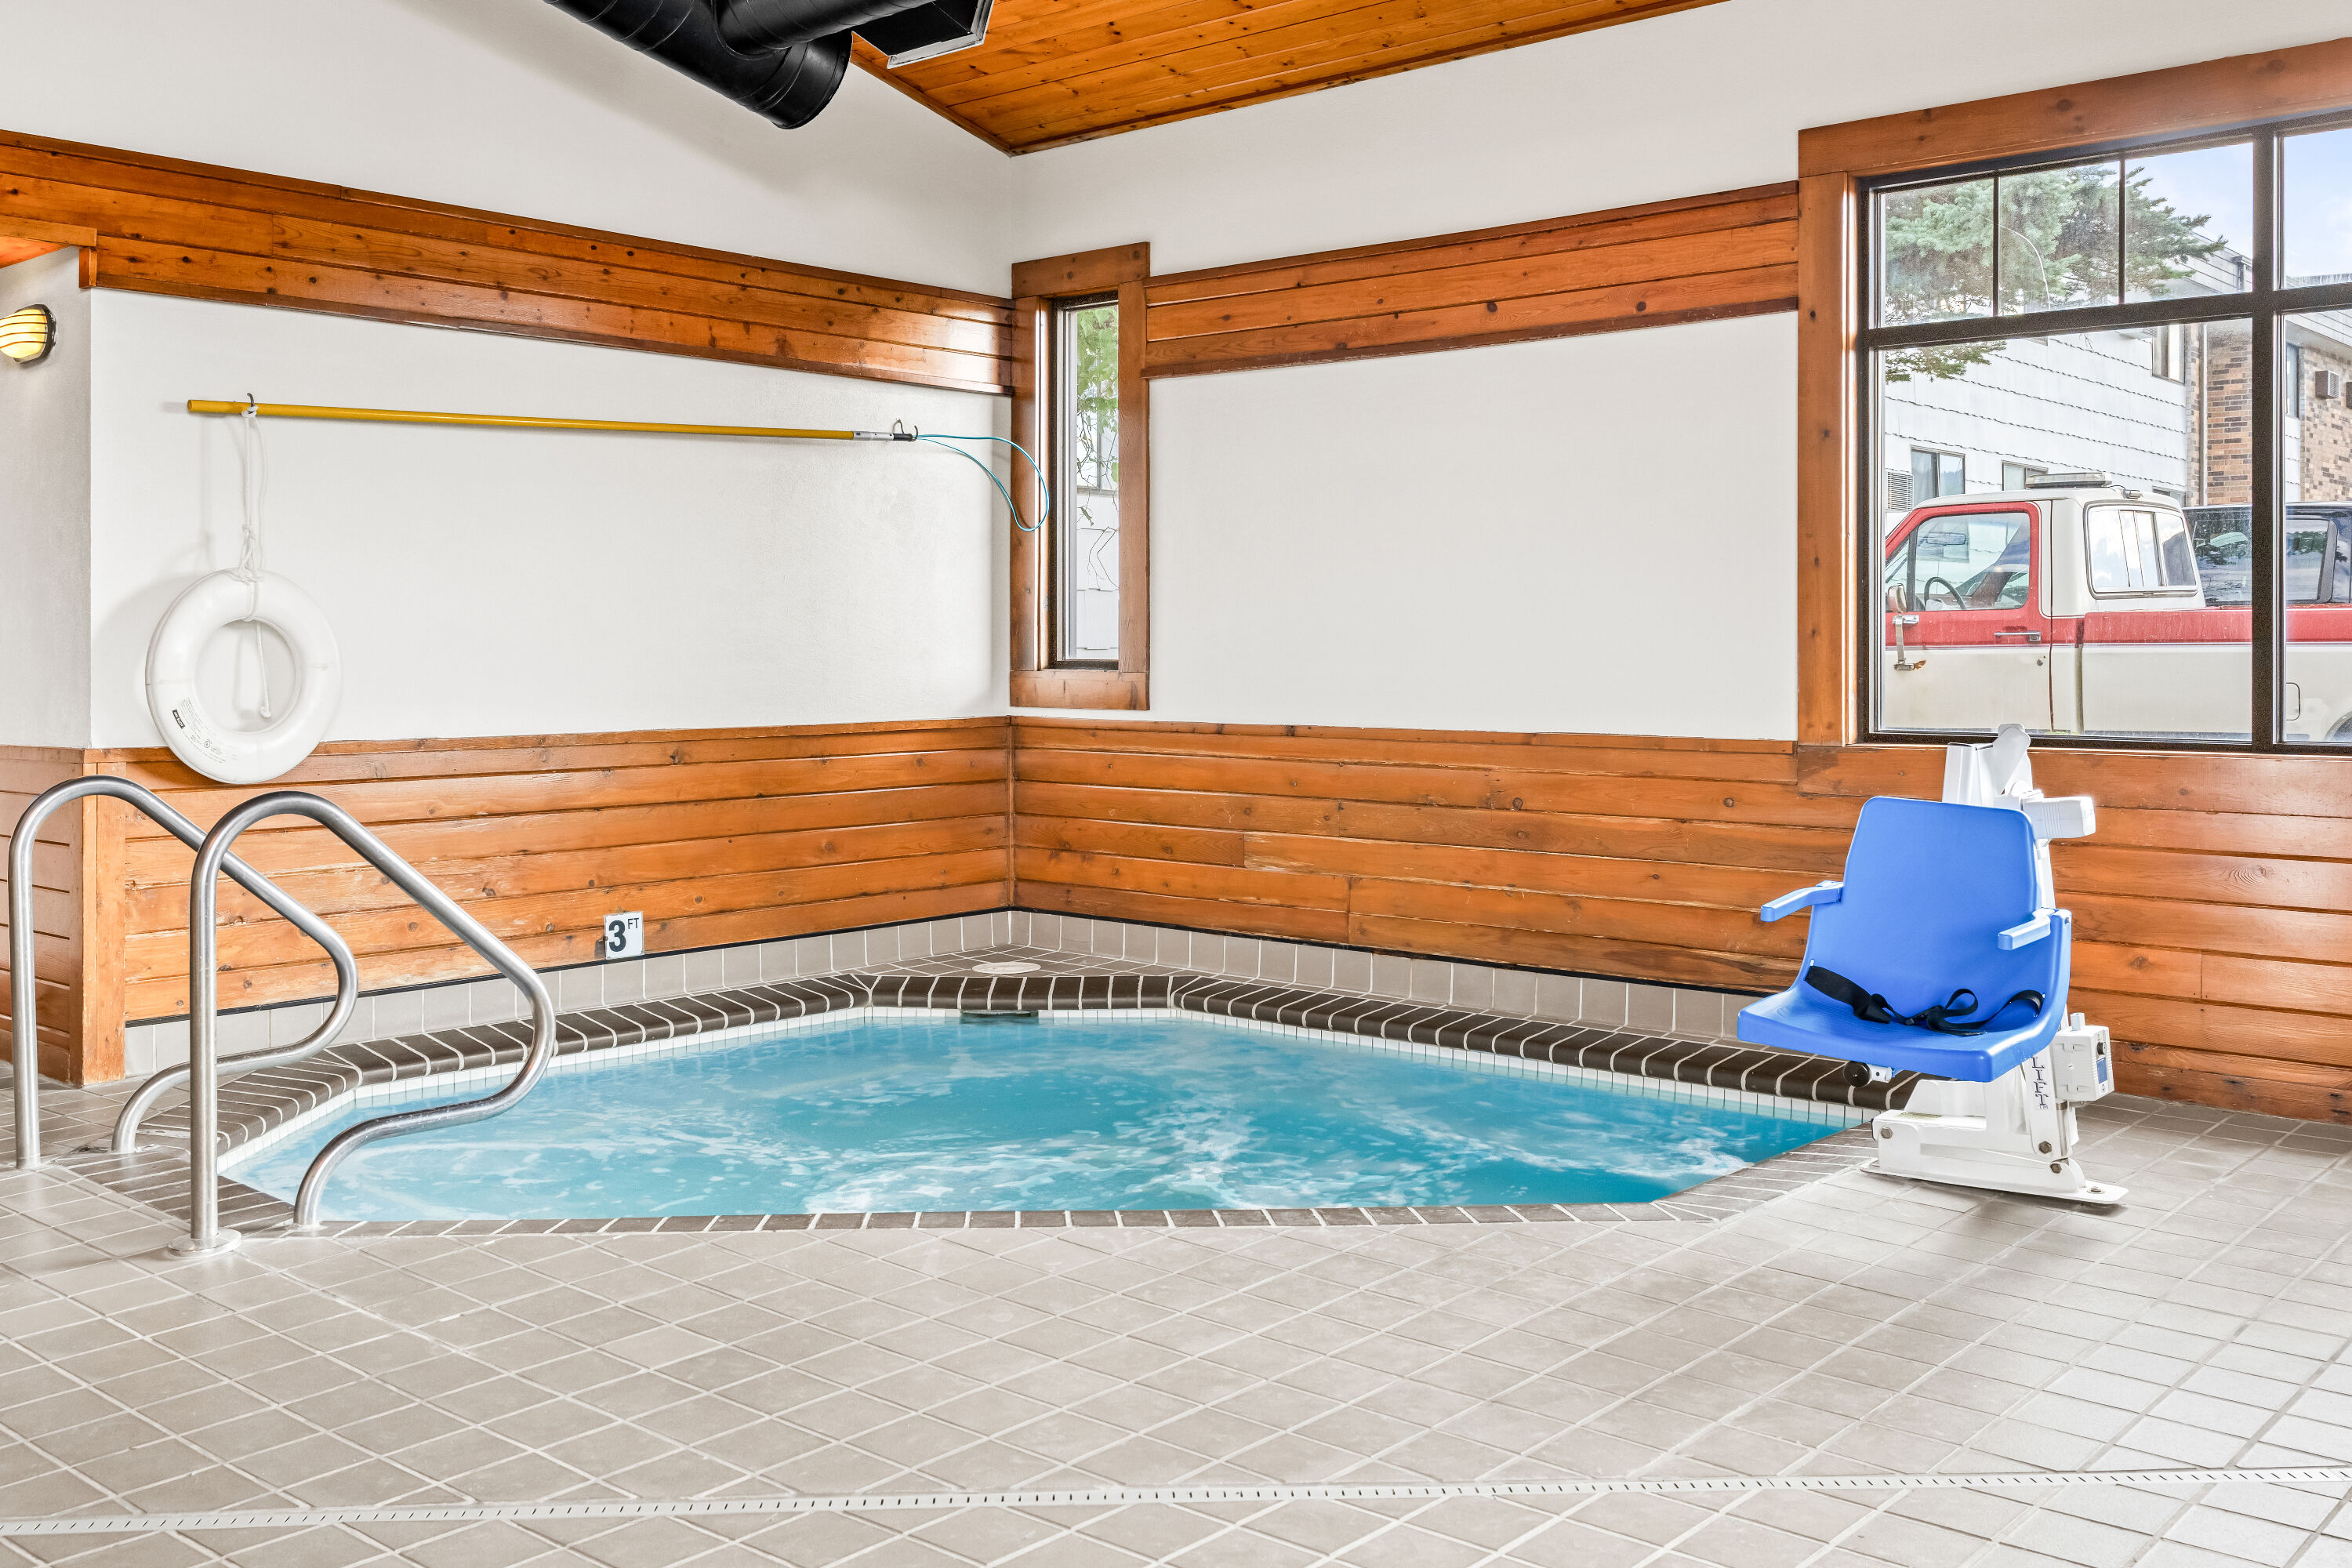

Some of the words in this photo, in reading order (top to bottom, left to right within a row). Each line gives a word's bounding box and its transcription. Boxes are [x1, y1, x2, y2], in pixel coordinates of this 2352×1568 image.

[608, 920, 626, 952] 3
[627, 917, 640, 930] FT
[2031, 1057, 2049, 1105] LIFT
